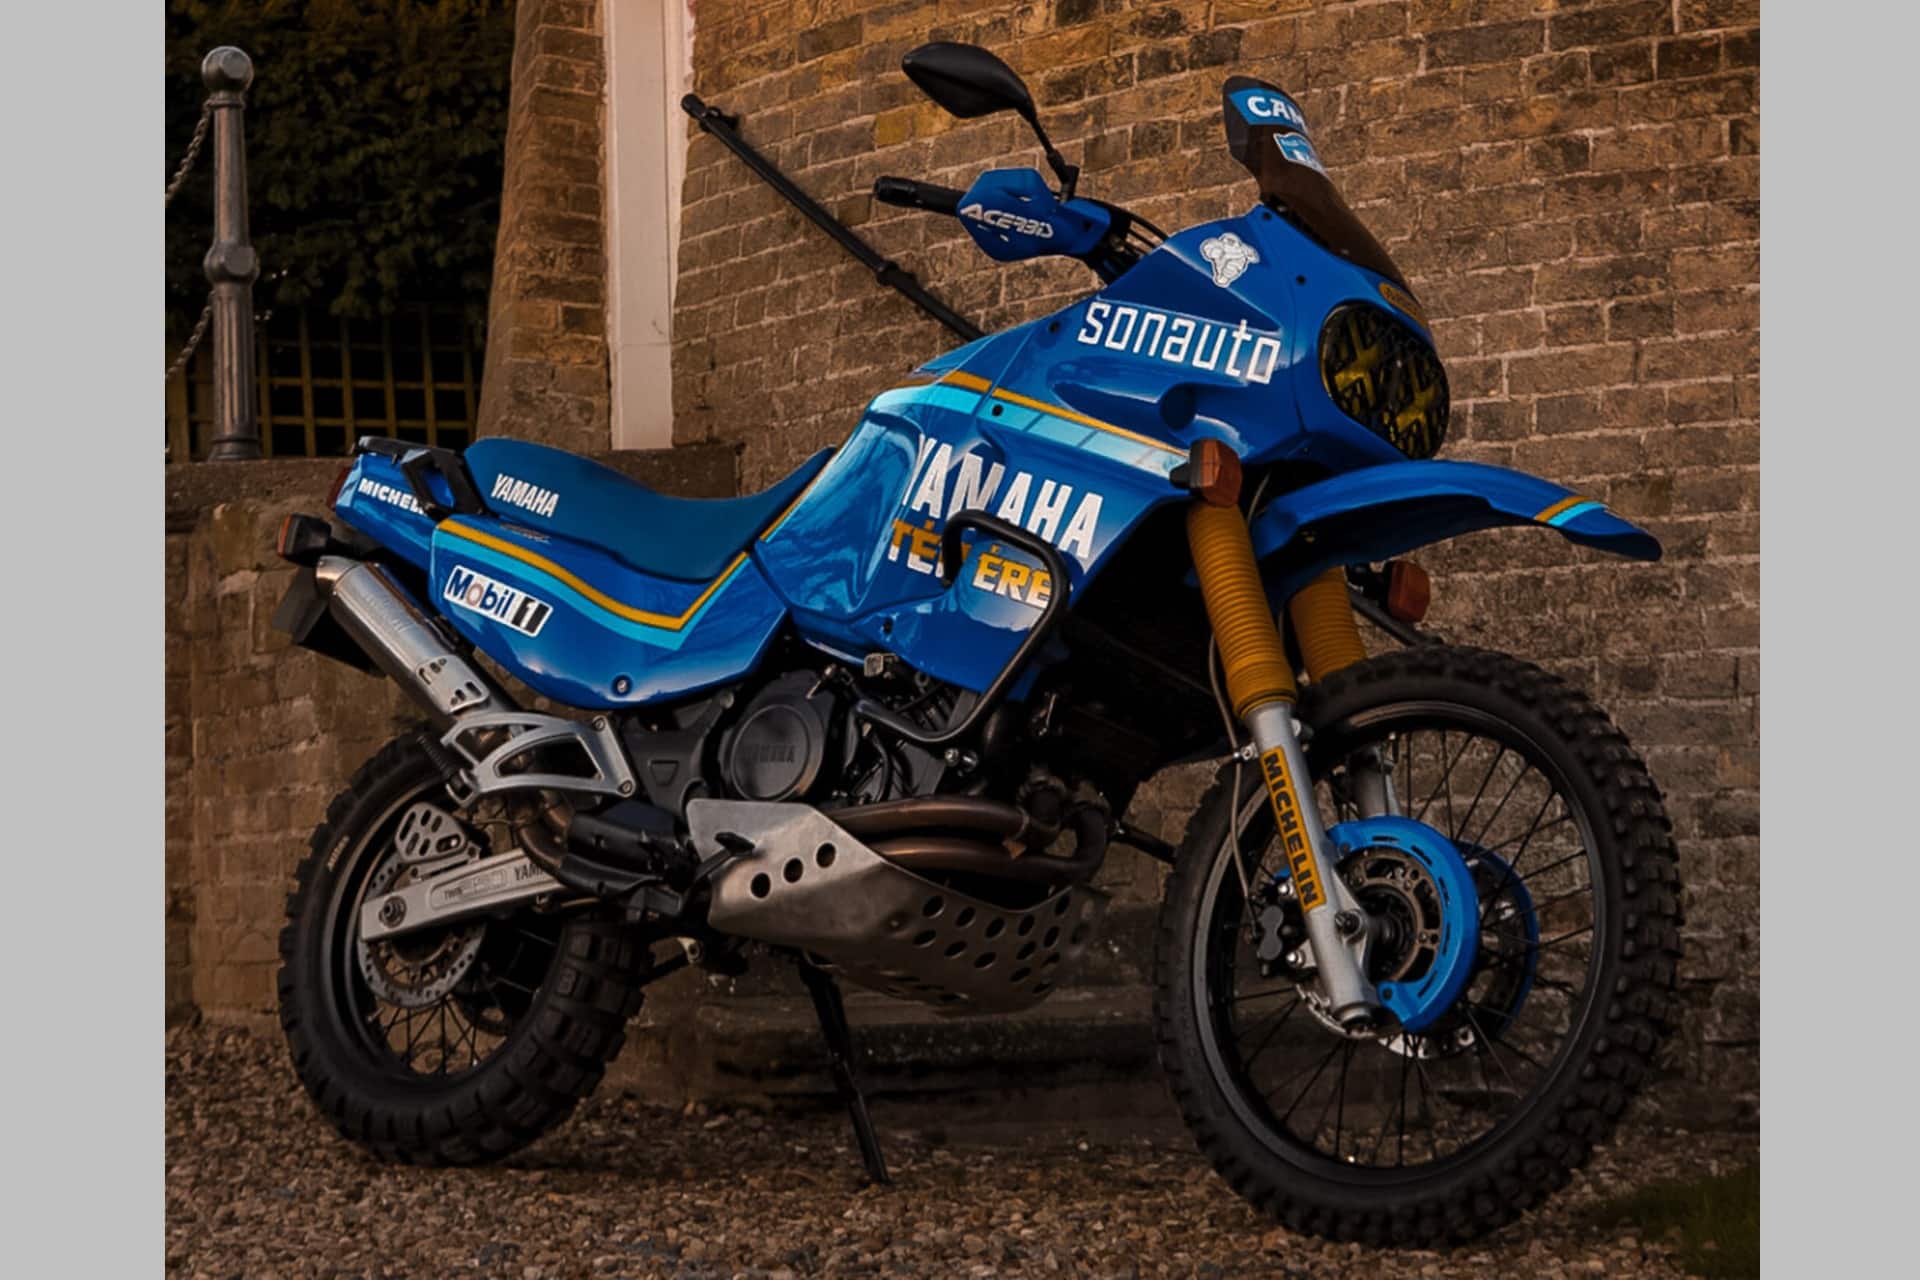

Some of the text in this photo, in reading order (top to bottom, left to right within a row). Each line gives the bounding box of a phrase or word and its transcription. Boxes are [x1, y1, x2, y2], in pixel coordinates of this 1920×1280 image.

[1077, 301, 1281, 384] sonauto
[358, 478, 428, 517] MICHEL
[490, 473, 560, 518] YAMAHA
[902, 433, 1104, 559] YAMAHA
[447, 568, 516, 619] Mobil
[1263, 752, 1319, 905] MICHELIN
